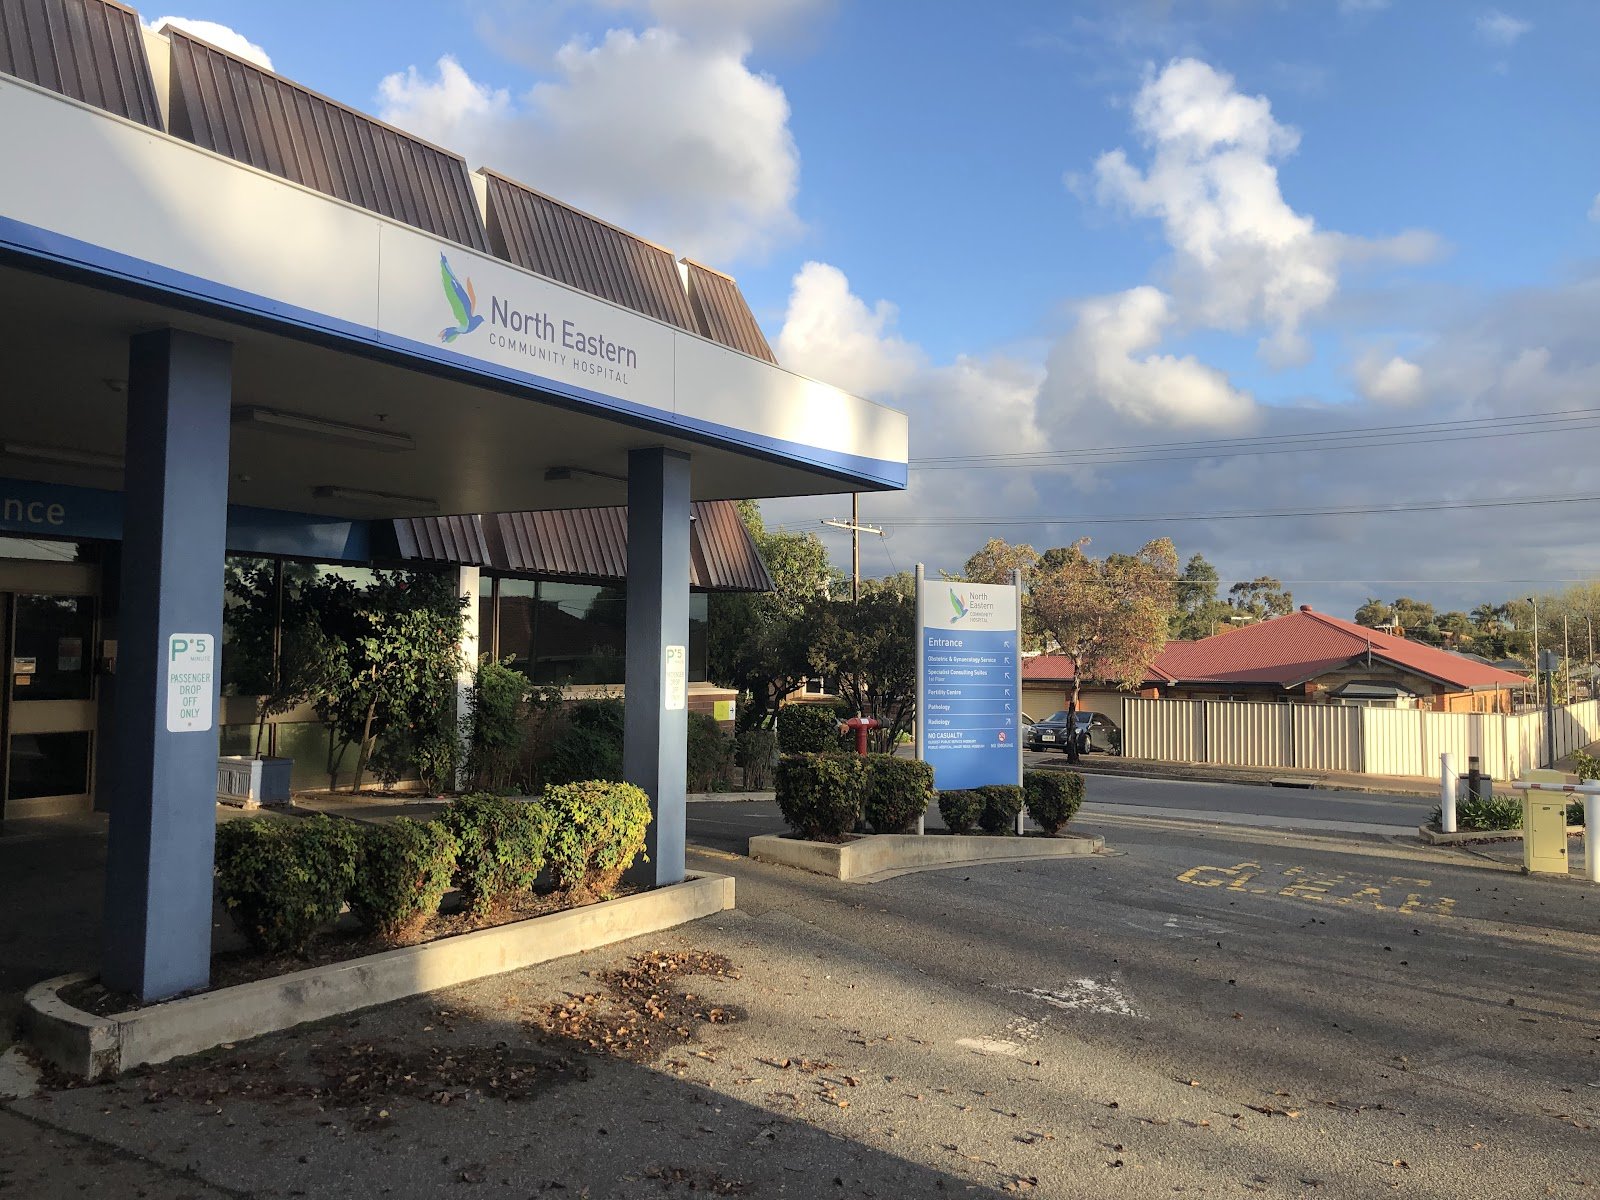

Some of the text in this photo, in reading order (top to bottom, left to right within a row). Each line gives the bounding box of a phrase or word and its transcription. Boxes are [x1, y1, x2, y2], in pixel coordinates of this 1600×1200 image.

[491, 295, 637, 369] North Eastern
[489, 333, 629, 385] COMMUNITY HOSPITAL
[970, 592, 988, 601] North
[970, 601, 994, 610] Eastern
[928, 637, 963, 647] Entrance
[172, 639, 206, 661] P 5
[928, 668, 950, 676] Specialist
[950, 669, 974, 677] Consulting
[170, 673, 211, 683] PASSENGER
[179, 684, 202, 695] DROP
[183, 696, 198, 707] OFF
[928, 703, 950, 712] Pathology
[180, 708, 200, 719] ONLY
[928, 718, 950, 726] Radiology
[936, 731, 963, 739] CASUALTY
